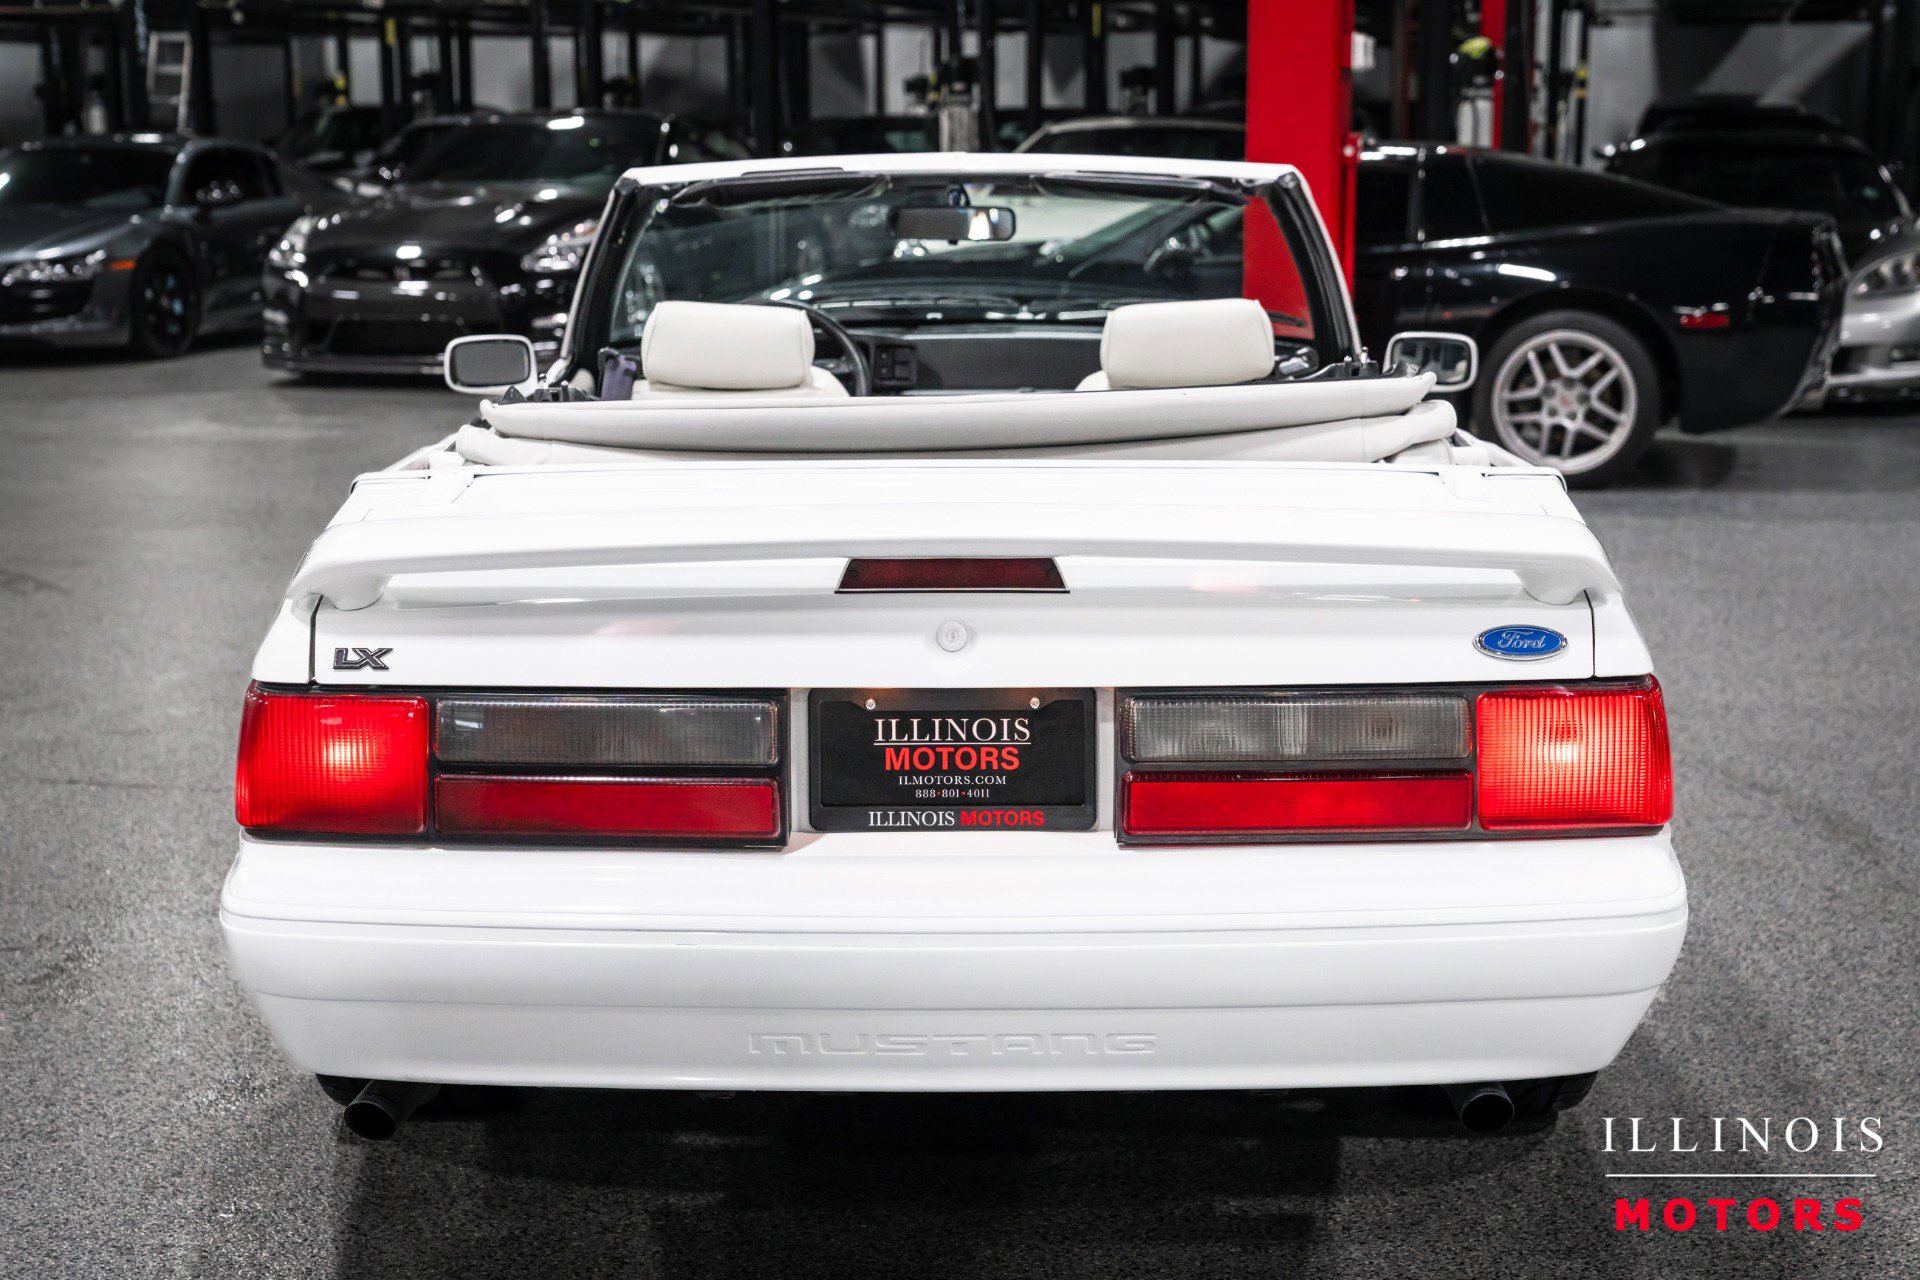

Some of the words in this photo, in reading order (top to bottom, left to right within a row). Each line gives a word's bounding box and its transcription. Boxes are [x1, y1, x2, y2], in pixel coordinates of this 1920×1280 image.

[1497, 630, 1546, 649] Ford
[332, 647, 393, 670] LX
[875, 718, 1030, 741] ILLINOIS
[885, 747, 1020, 771] MOTORS
[899, 776, 1006, 785] ILMOTORS.COM
[868, 811, 955, 827] ILLINOIS
[960, 810, 1045, 826] MOTORS
[748, 1033, 1157, 1055] MUSTANG
